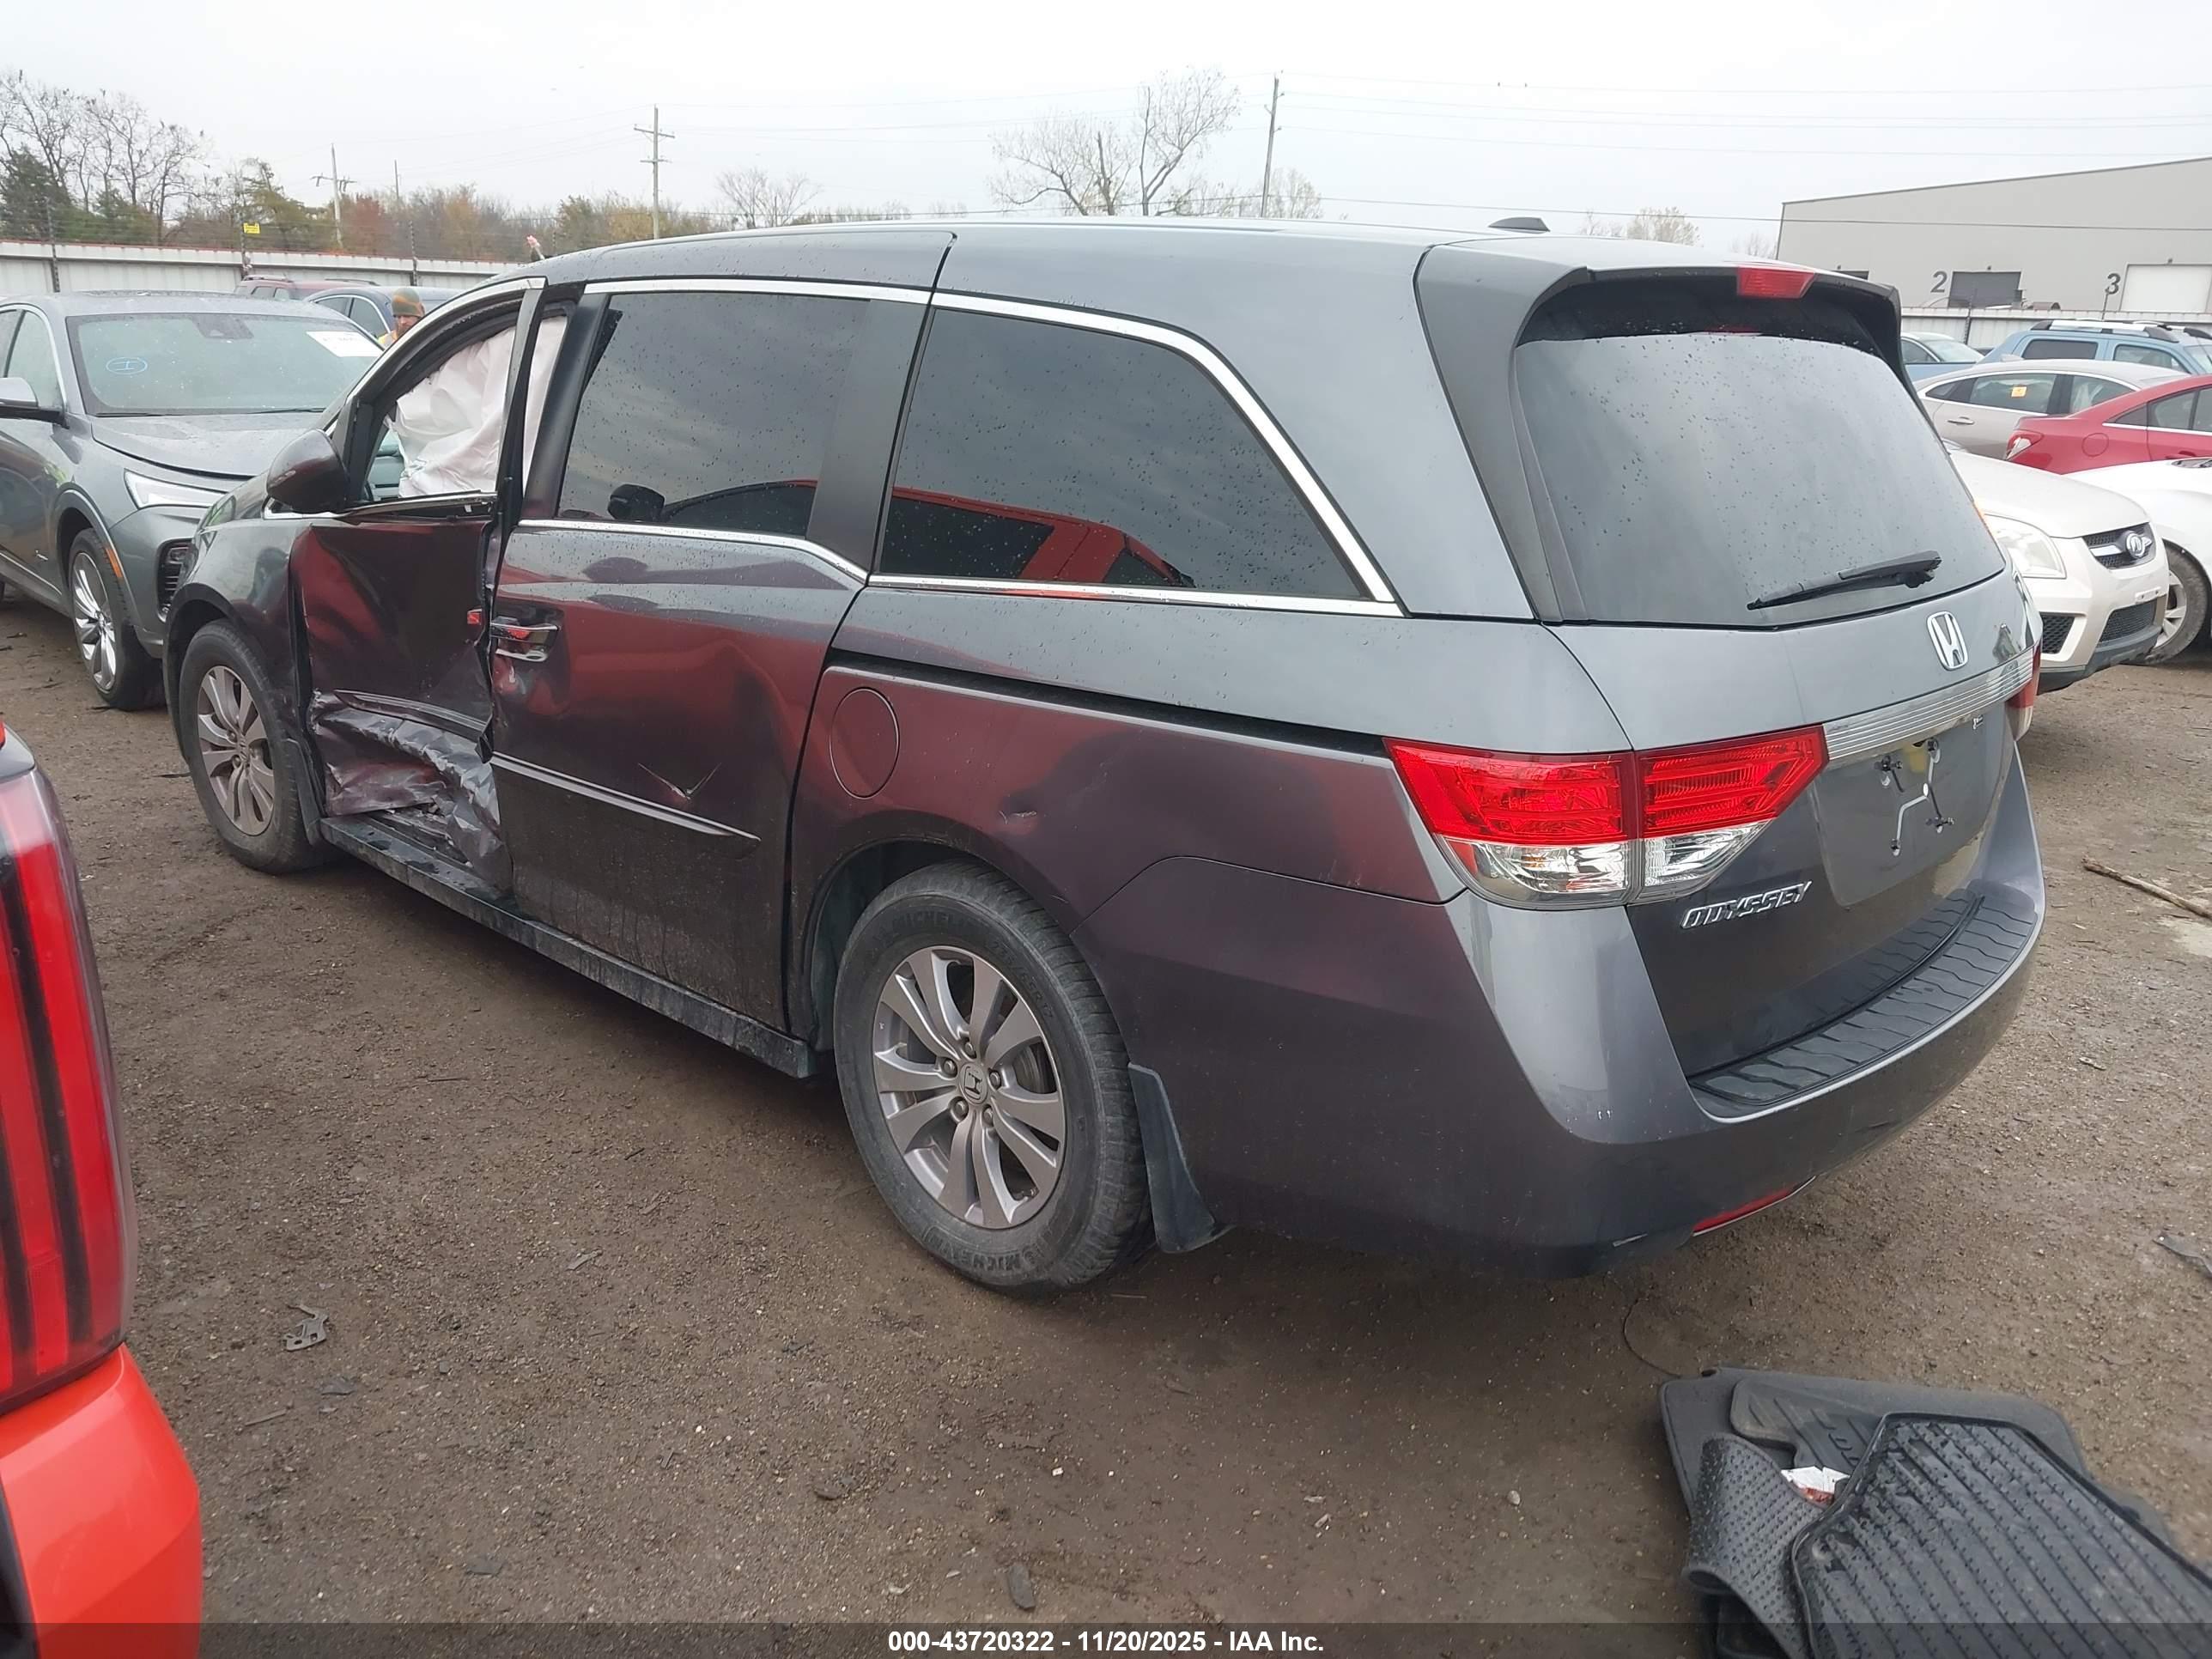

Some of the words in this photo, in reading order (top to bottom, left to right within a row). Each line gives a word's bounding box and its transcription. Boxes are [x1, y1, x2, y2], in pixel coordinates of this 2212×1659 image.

[1930, 270, 1948, 294] 2
[2105, 272, 2122, 295] 3
[1680, 880, 1813, 929] ODYSSEY
